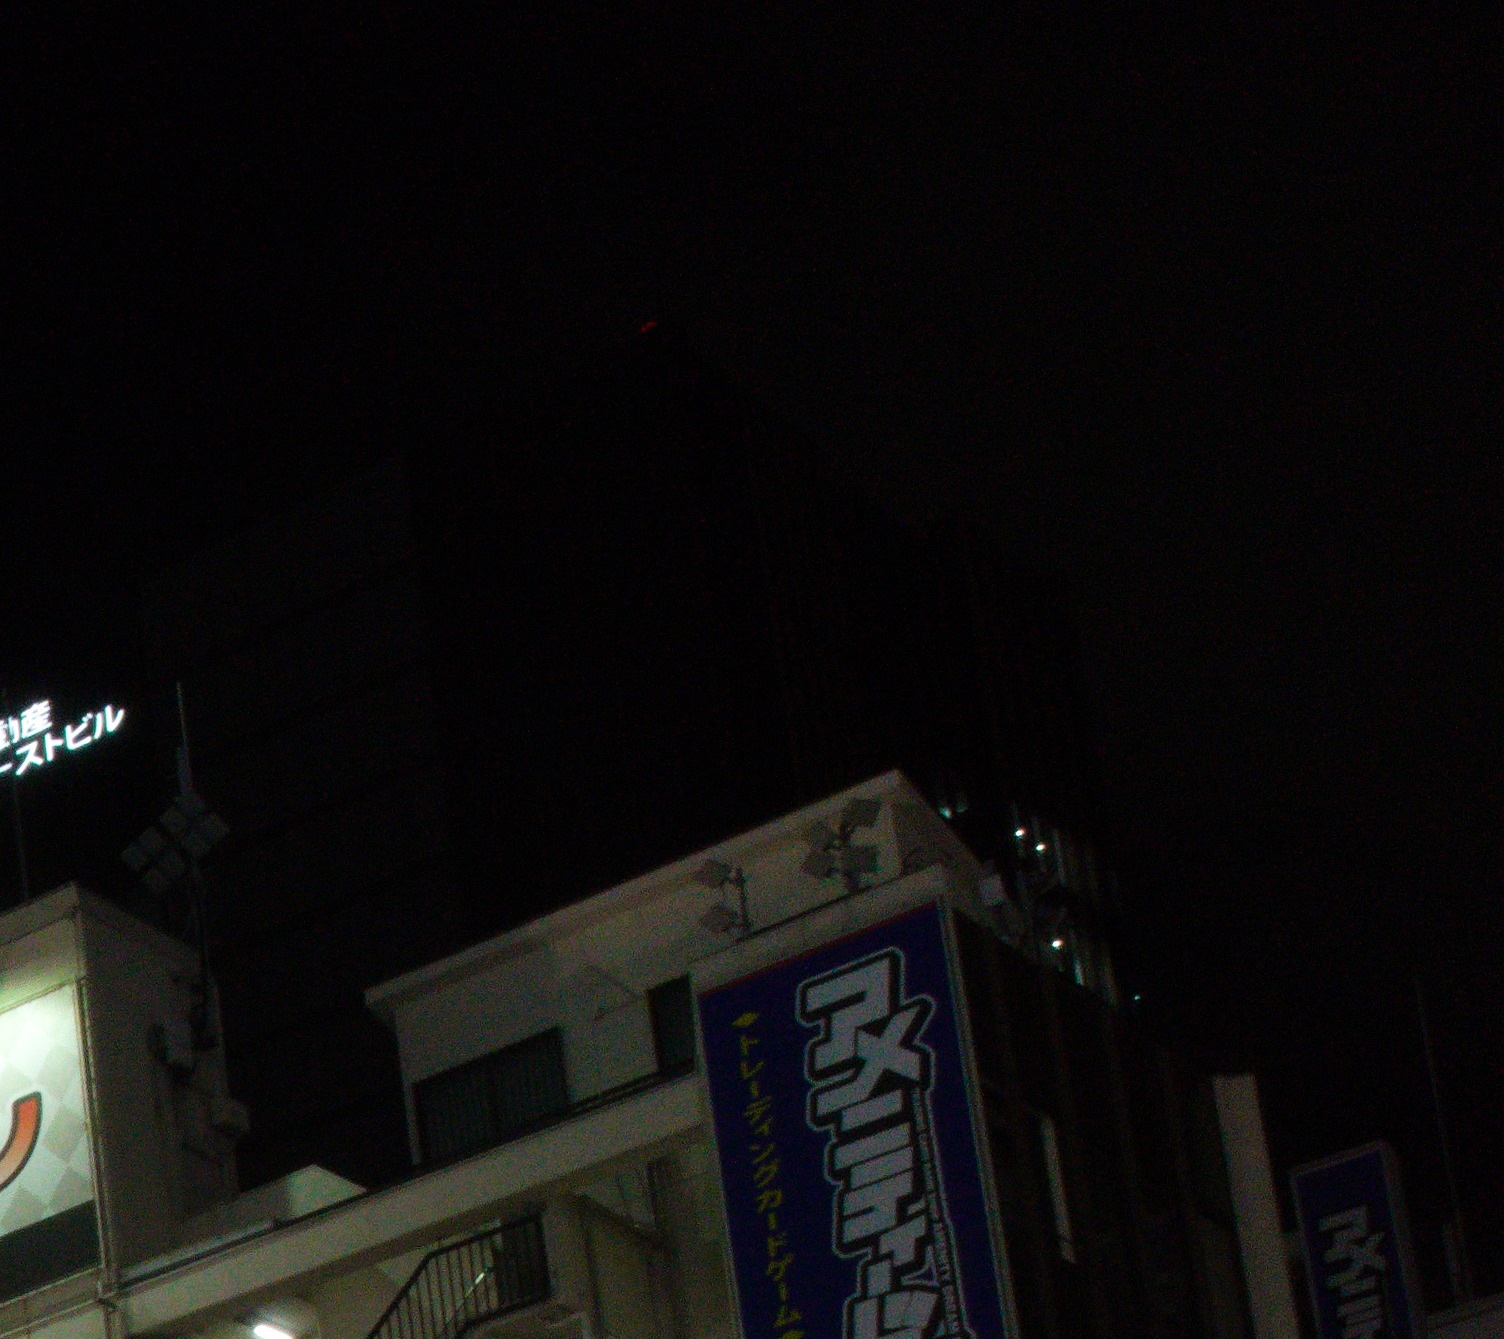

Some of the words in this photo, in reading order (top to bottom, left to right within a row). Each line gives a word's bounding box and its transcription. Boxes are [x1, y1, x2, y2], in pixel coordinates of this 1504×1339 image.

[738, 1035, 802, 1331] トレーディングカードゲーム
